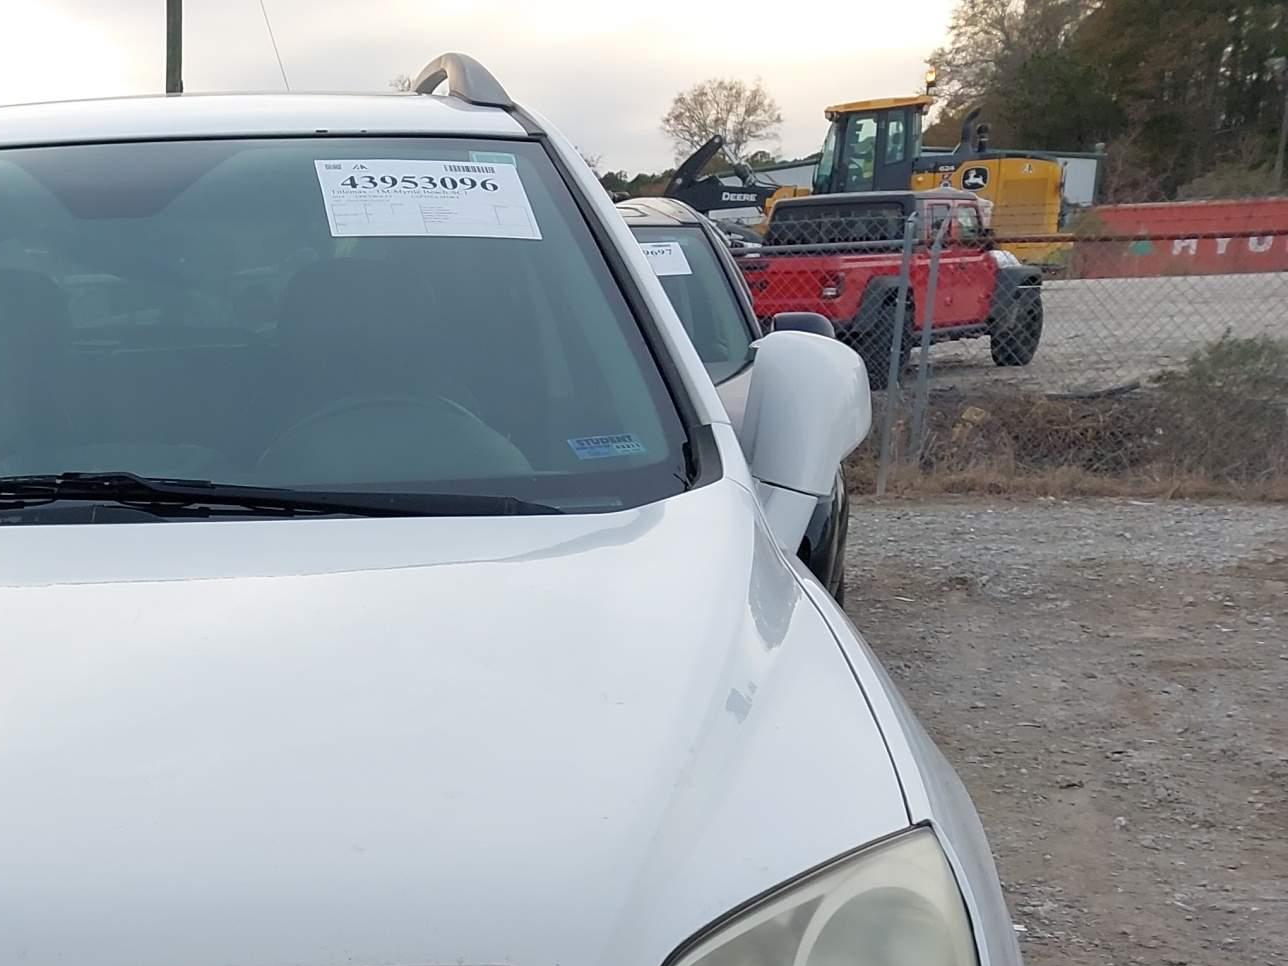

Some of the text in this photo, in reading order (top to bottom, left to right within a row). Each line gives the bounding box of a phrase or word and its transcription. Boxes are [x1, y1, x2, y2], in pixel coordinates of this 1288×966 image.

[340, 175, 499, 192] 43953096
[721, 191, 758, 202] DEERE
[1171, 234, 1288, 255] HYU
